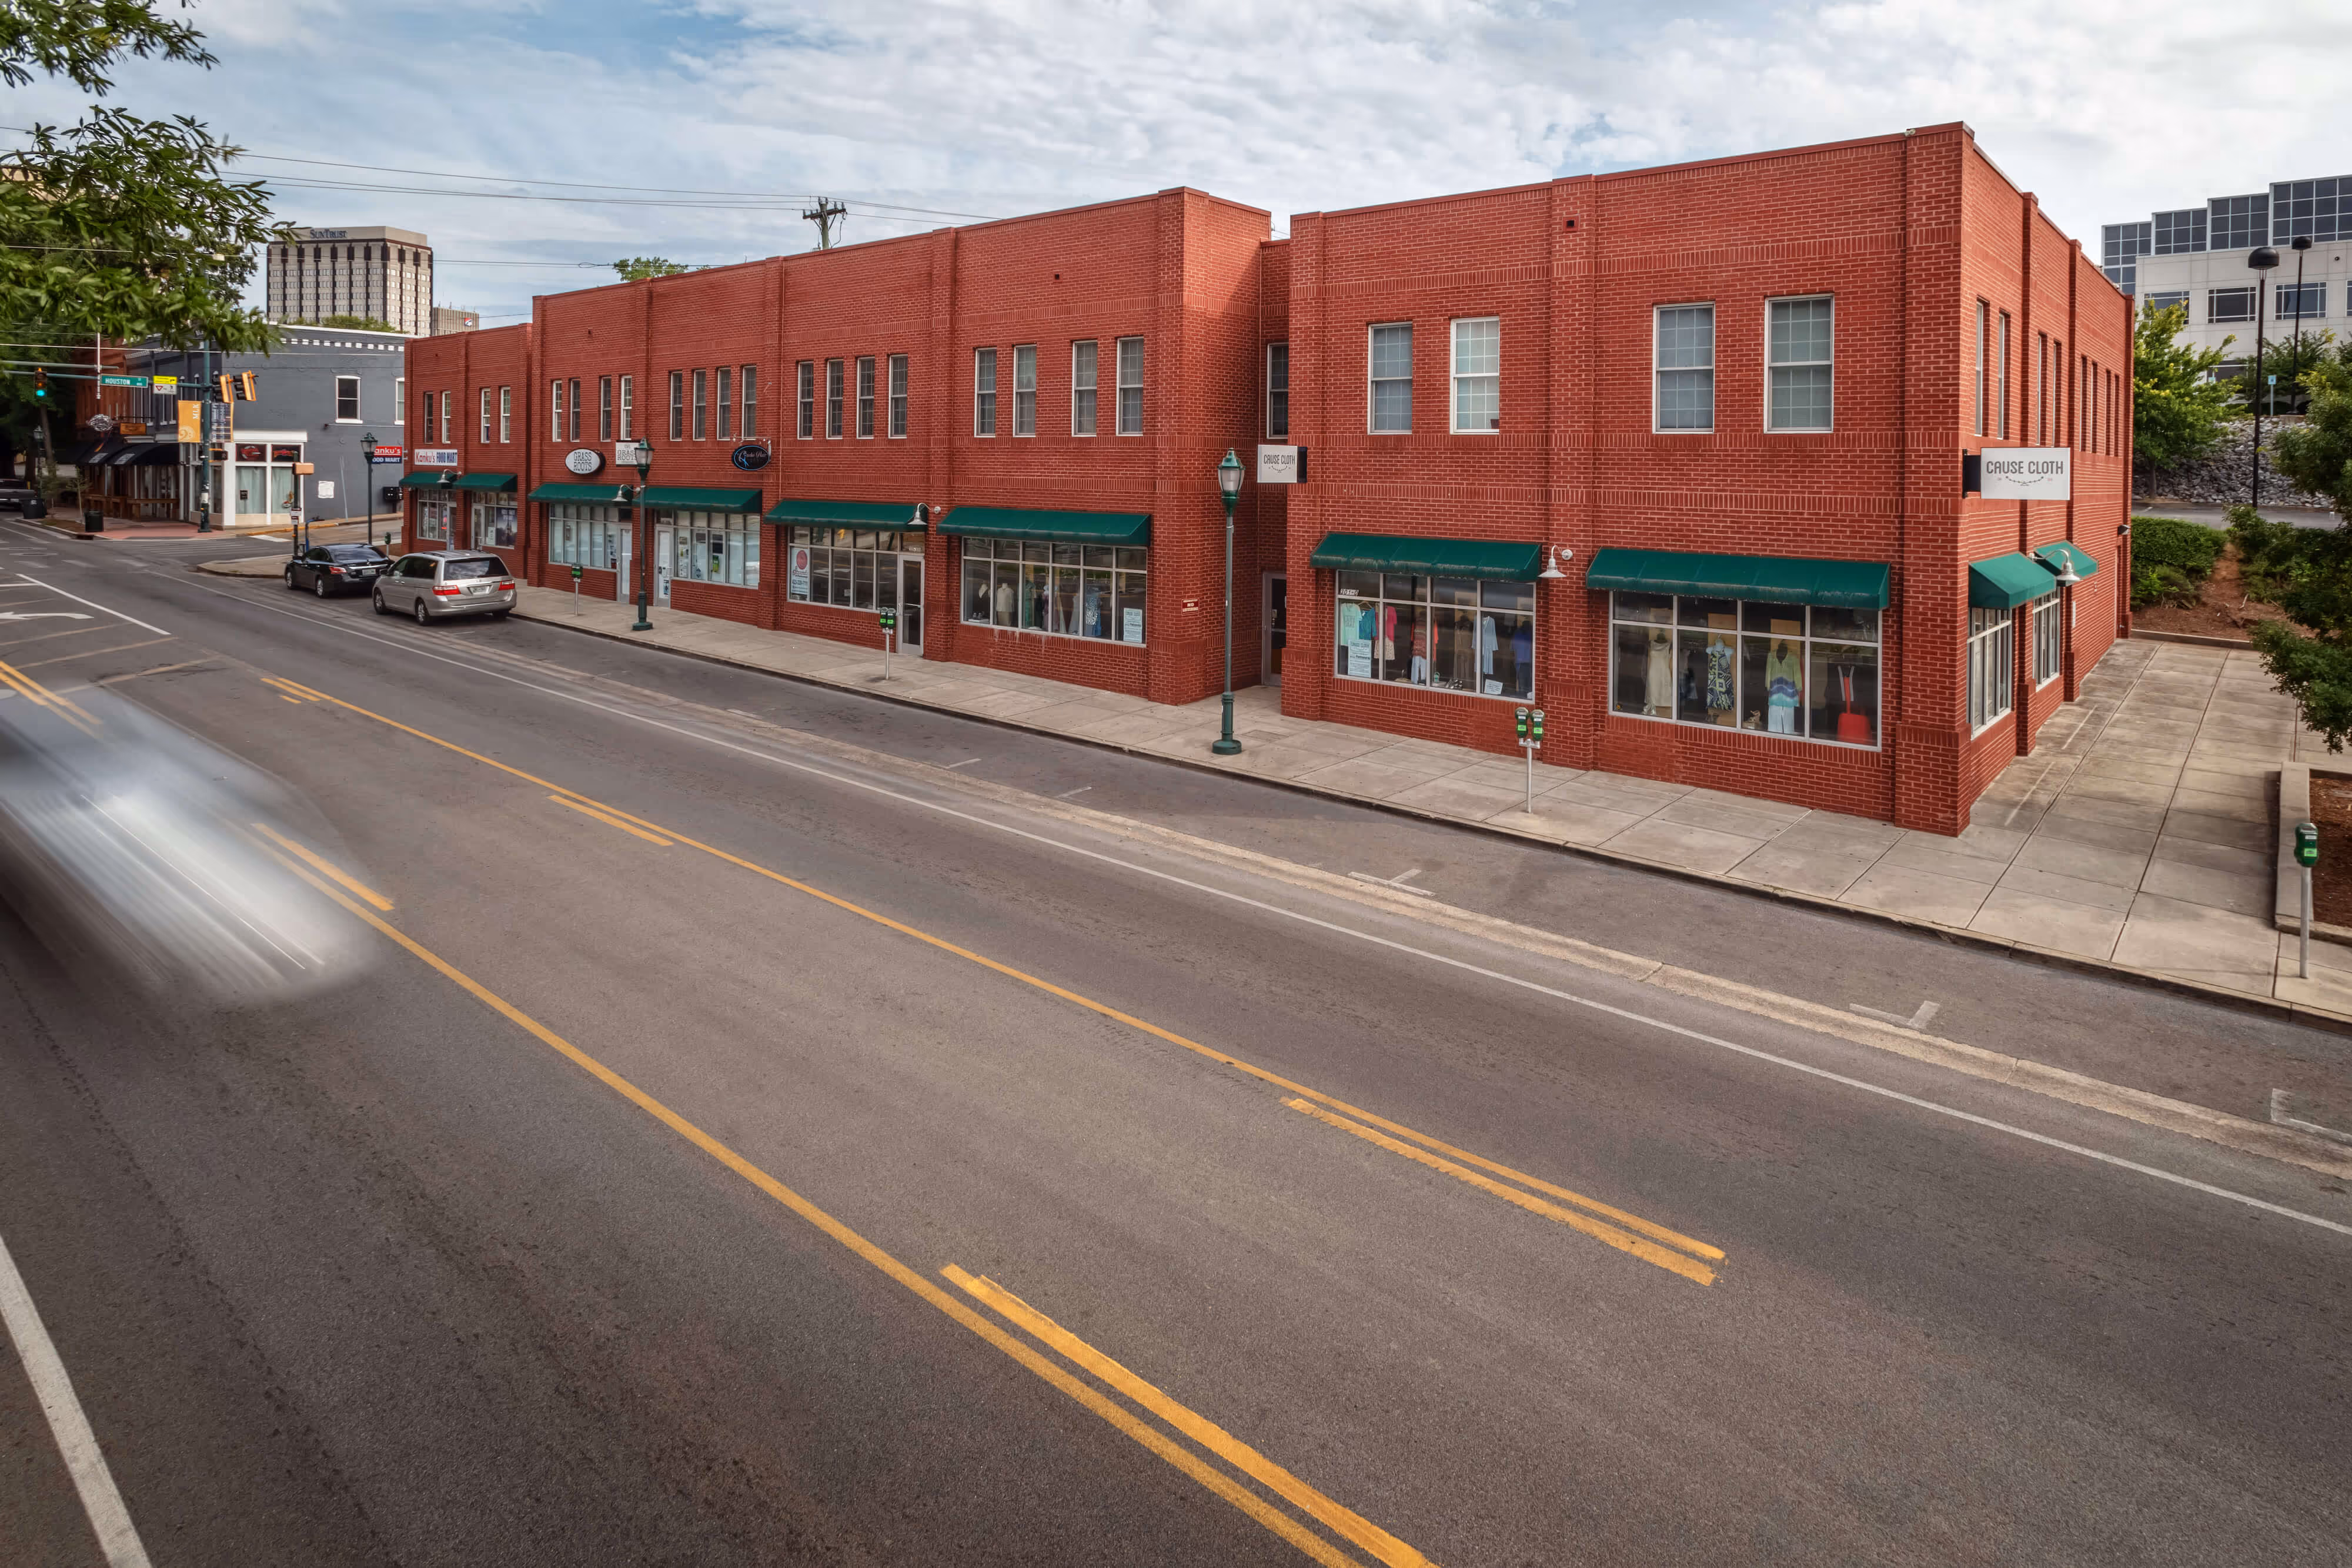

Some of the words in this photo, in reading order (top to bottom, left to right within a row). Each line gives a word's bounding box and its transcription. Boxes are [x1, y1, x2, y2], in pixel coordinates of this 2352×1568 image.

[415, 452, 435, 463] Kanku's
[436, 452, 446, 463] FOOD
[446, 452, 457, 463] MART
[573, 452, 592, 462] GRASS
[1264, 454, 1279, 464] CAUSE
[1281, 455, 1295, 464] CLOTH
[573, 462, 592, 471] ROOTS
[1986, 461, 2024, 474] CAUSE
[2028, 461, 2063, 474] CLOTH
